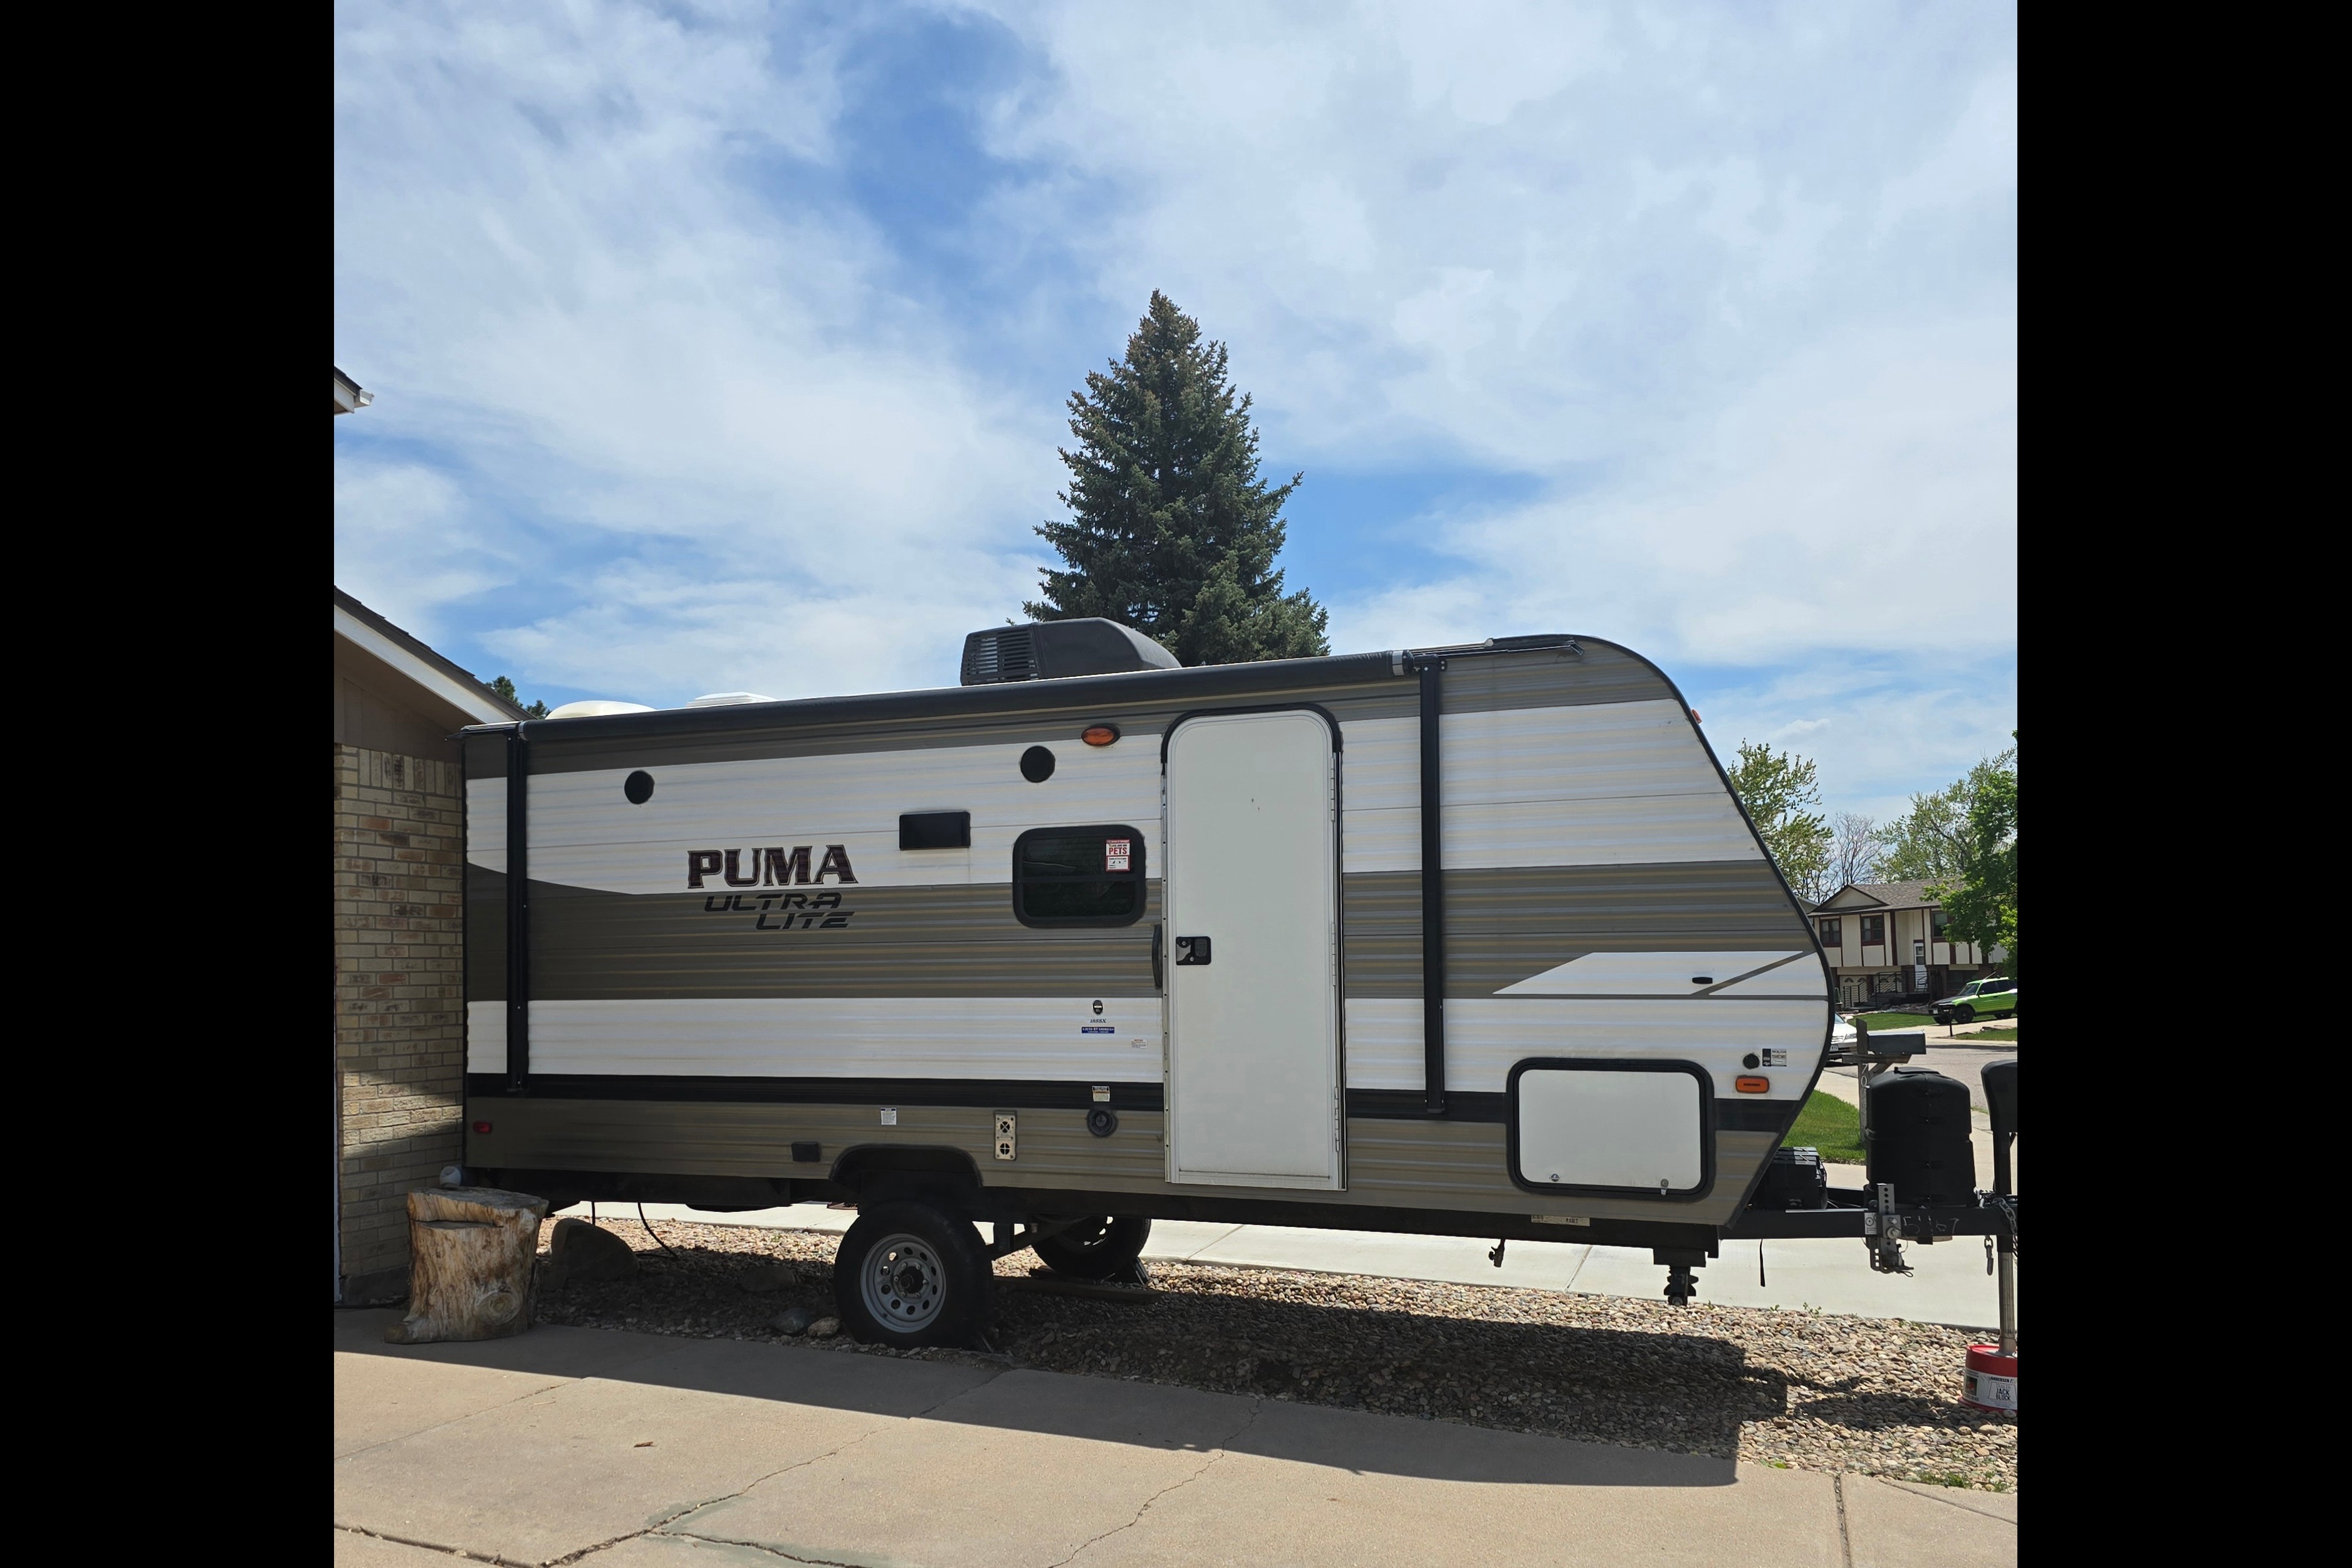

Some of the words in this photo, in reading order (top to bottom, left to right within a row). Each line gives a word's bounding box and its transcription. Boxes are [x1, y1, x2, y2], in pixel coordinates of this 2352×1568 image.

[1109, 847, 1127, 855] PETS
[687, 844, 859, 889] PUMA
[704, 892, 842, 912] ULTRA
[756, 911, 855, 930] LITE
[1997, 1388, 2010, 1396] JACK
